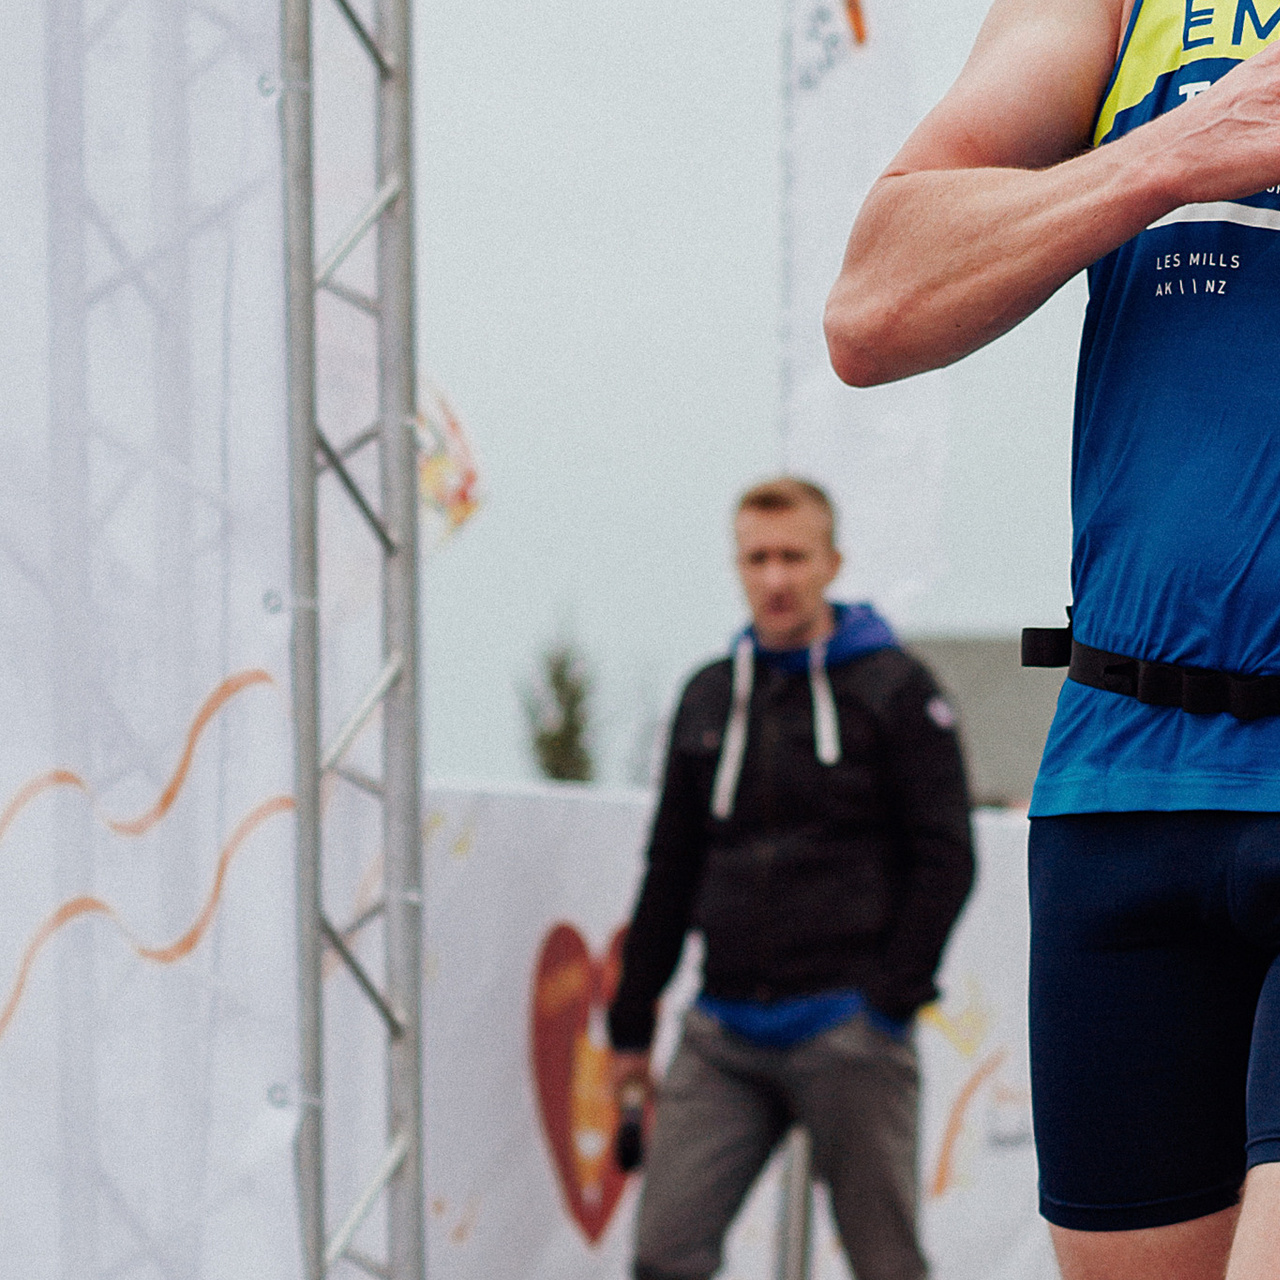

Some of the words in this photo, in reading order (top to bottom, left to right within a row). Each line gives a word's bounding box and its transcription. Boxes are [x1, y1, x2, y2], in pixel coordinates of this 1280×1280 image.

[1156, 253, 1182, 271] LES
[1189, 252, 1241, 269] MILLS
[1155, 282, 1173, 297] AK
[1205, 279, 1227, 295] NZ
